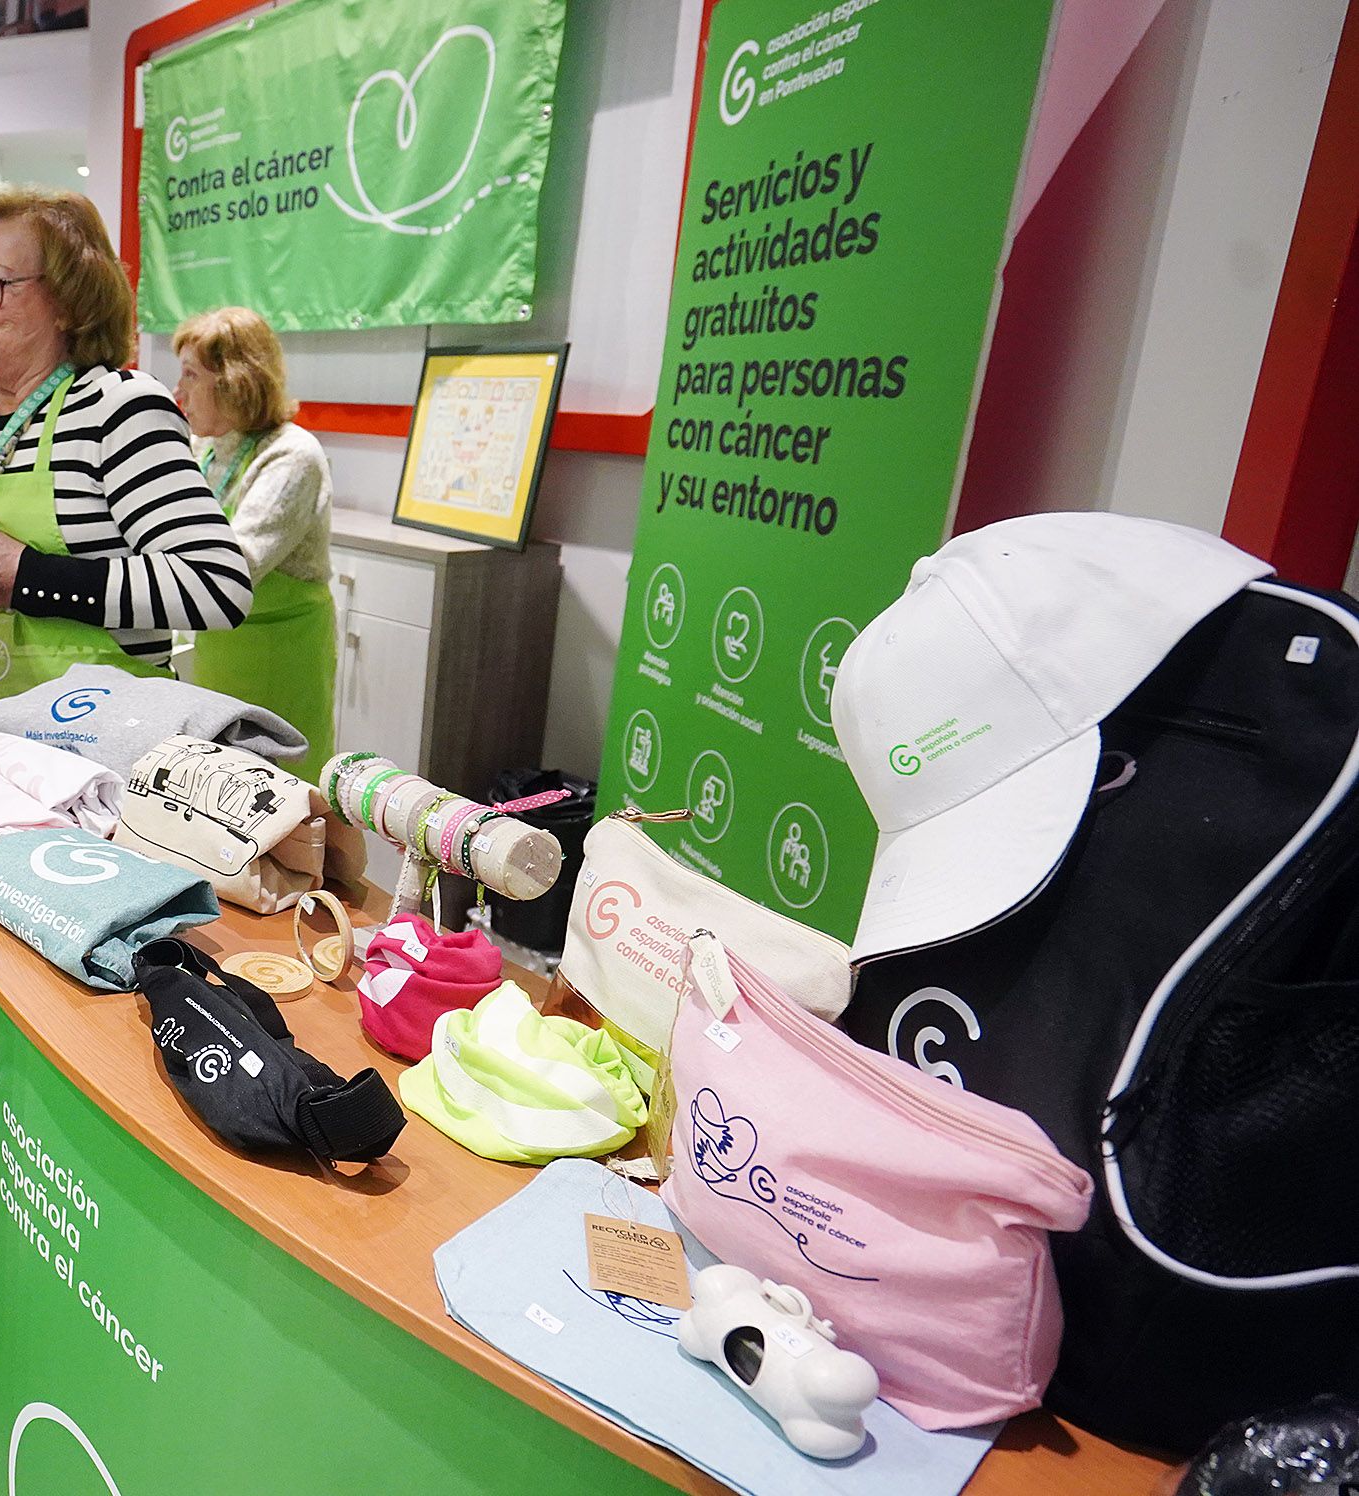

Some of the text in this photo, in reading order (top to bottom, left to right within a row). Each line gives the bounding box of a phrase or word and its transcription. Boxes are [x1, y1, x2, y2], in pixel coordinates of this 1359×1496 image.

[762, 22, 863, 81] contra el cáncer
[766, 11, 831, 55] asociación
[758, 56, 845, 107] en Pontevedra
[166, 144, 334, 201] Contra el cáncer
[701, 142, 875, 226] Servicios y
[168, 185, 319, 233] somos solo uno
[692, 206, 881, 284] actividades
[682, 286, 818, 351] gratuitos
[674, 353, 908, 407] para personas
[667, 408, 832, 466] con cáncer
[656, 470, 839, 537] y su entorno
[25, 731, 43, 740] Máis
[914, 717, 959, 745] asociación
[921, 730, 958, 753] española
[926, 744, 953, 761] contra
[961, 723, 992, 743] cancro
[12, 922, 45, 952] vida
[630, 927, 681, 965] española
[646, 915, 691, 945] asociac
[616, 941, 655, 972] contra
[654, 967, 669, 981] el
[709, 1024, 730, 1041] 3€
[3, 1101, 99, 1229] asociación
[1, 1140, 80, 1253] española
[784, 1196, 832, 1222] española
[786, 1185, 843, 1214] asociación
[591, 1224, 648, 1240] RECYCLED
[616, 1234, 649, 1246] COTTON
[782, 1206, 867, 1249] contra el cáncer
[0, 1177, 163, 1382] contra el cáncer
